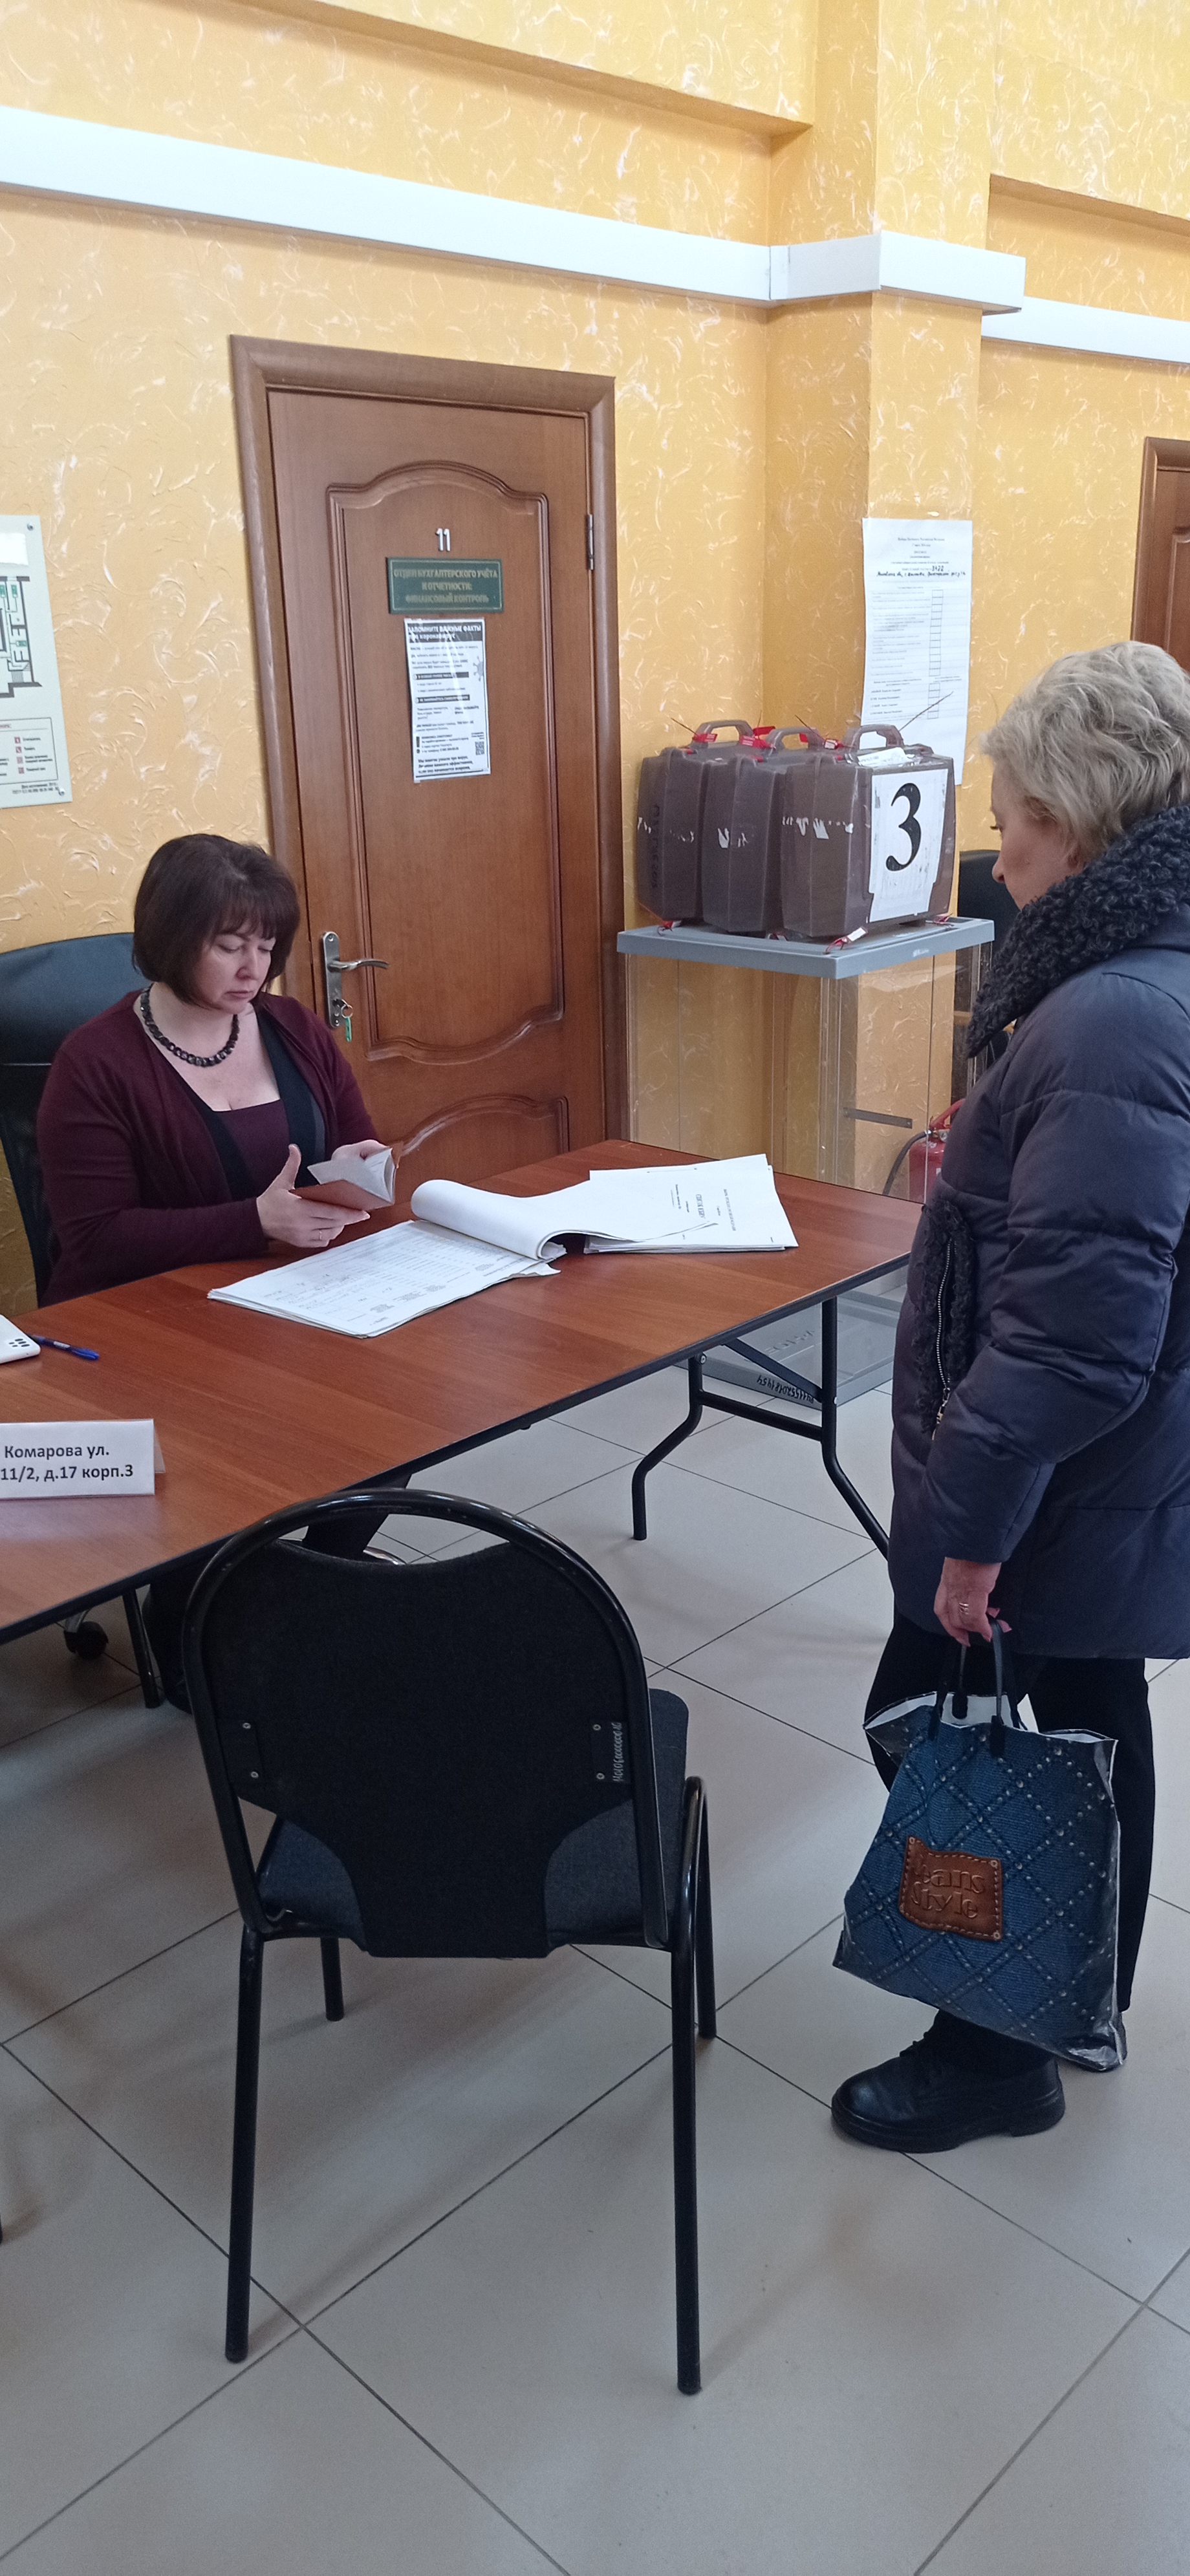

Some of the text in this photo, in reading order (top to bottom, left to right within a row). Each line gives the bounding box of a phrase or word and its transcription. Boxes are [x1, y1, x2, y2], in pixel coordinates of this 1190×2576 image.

[435, 528, 451, 552] 11
[417, 569, 476, 578] БУХГАЛТЕРСКОГО
[886, 782, 922, 872] 3
[5, 1446, 109, 1461] Комарова ул.
[1, 1464, 133, 1483] 11/2, д.17 корп.3
[911, 1880, 979, 1918] Style
